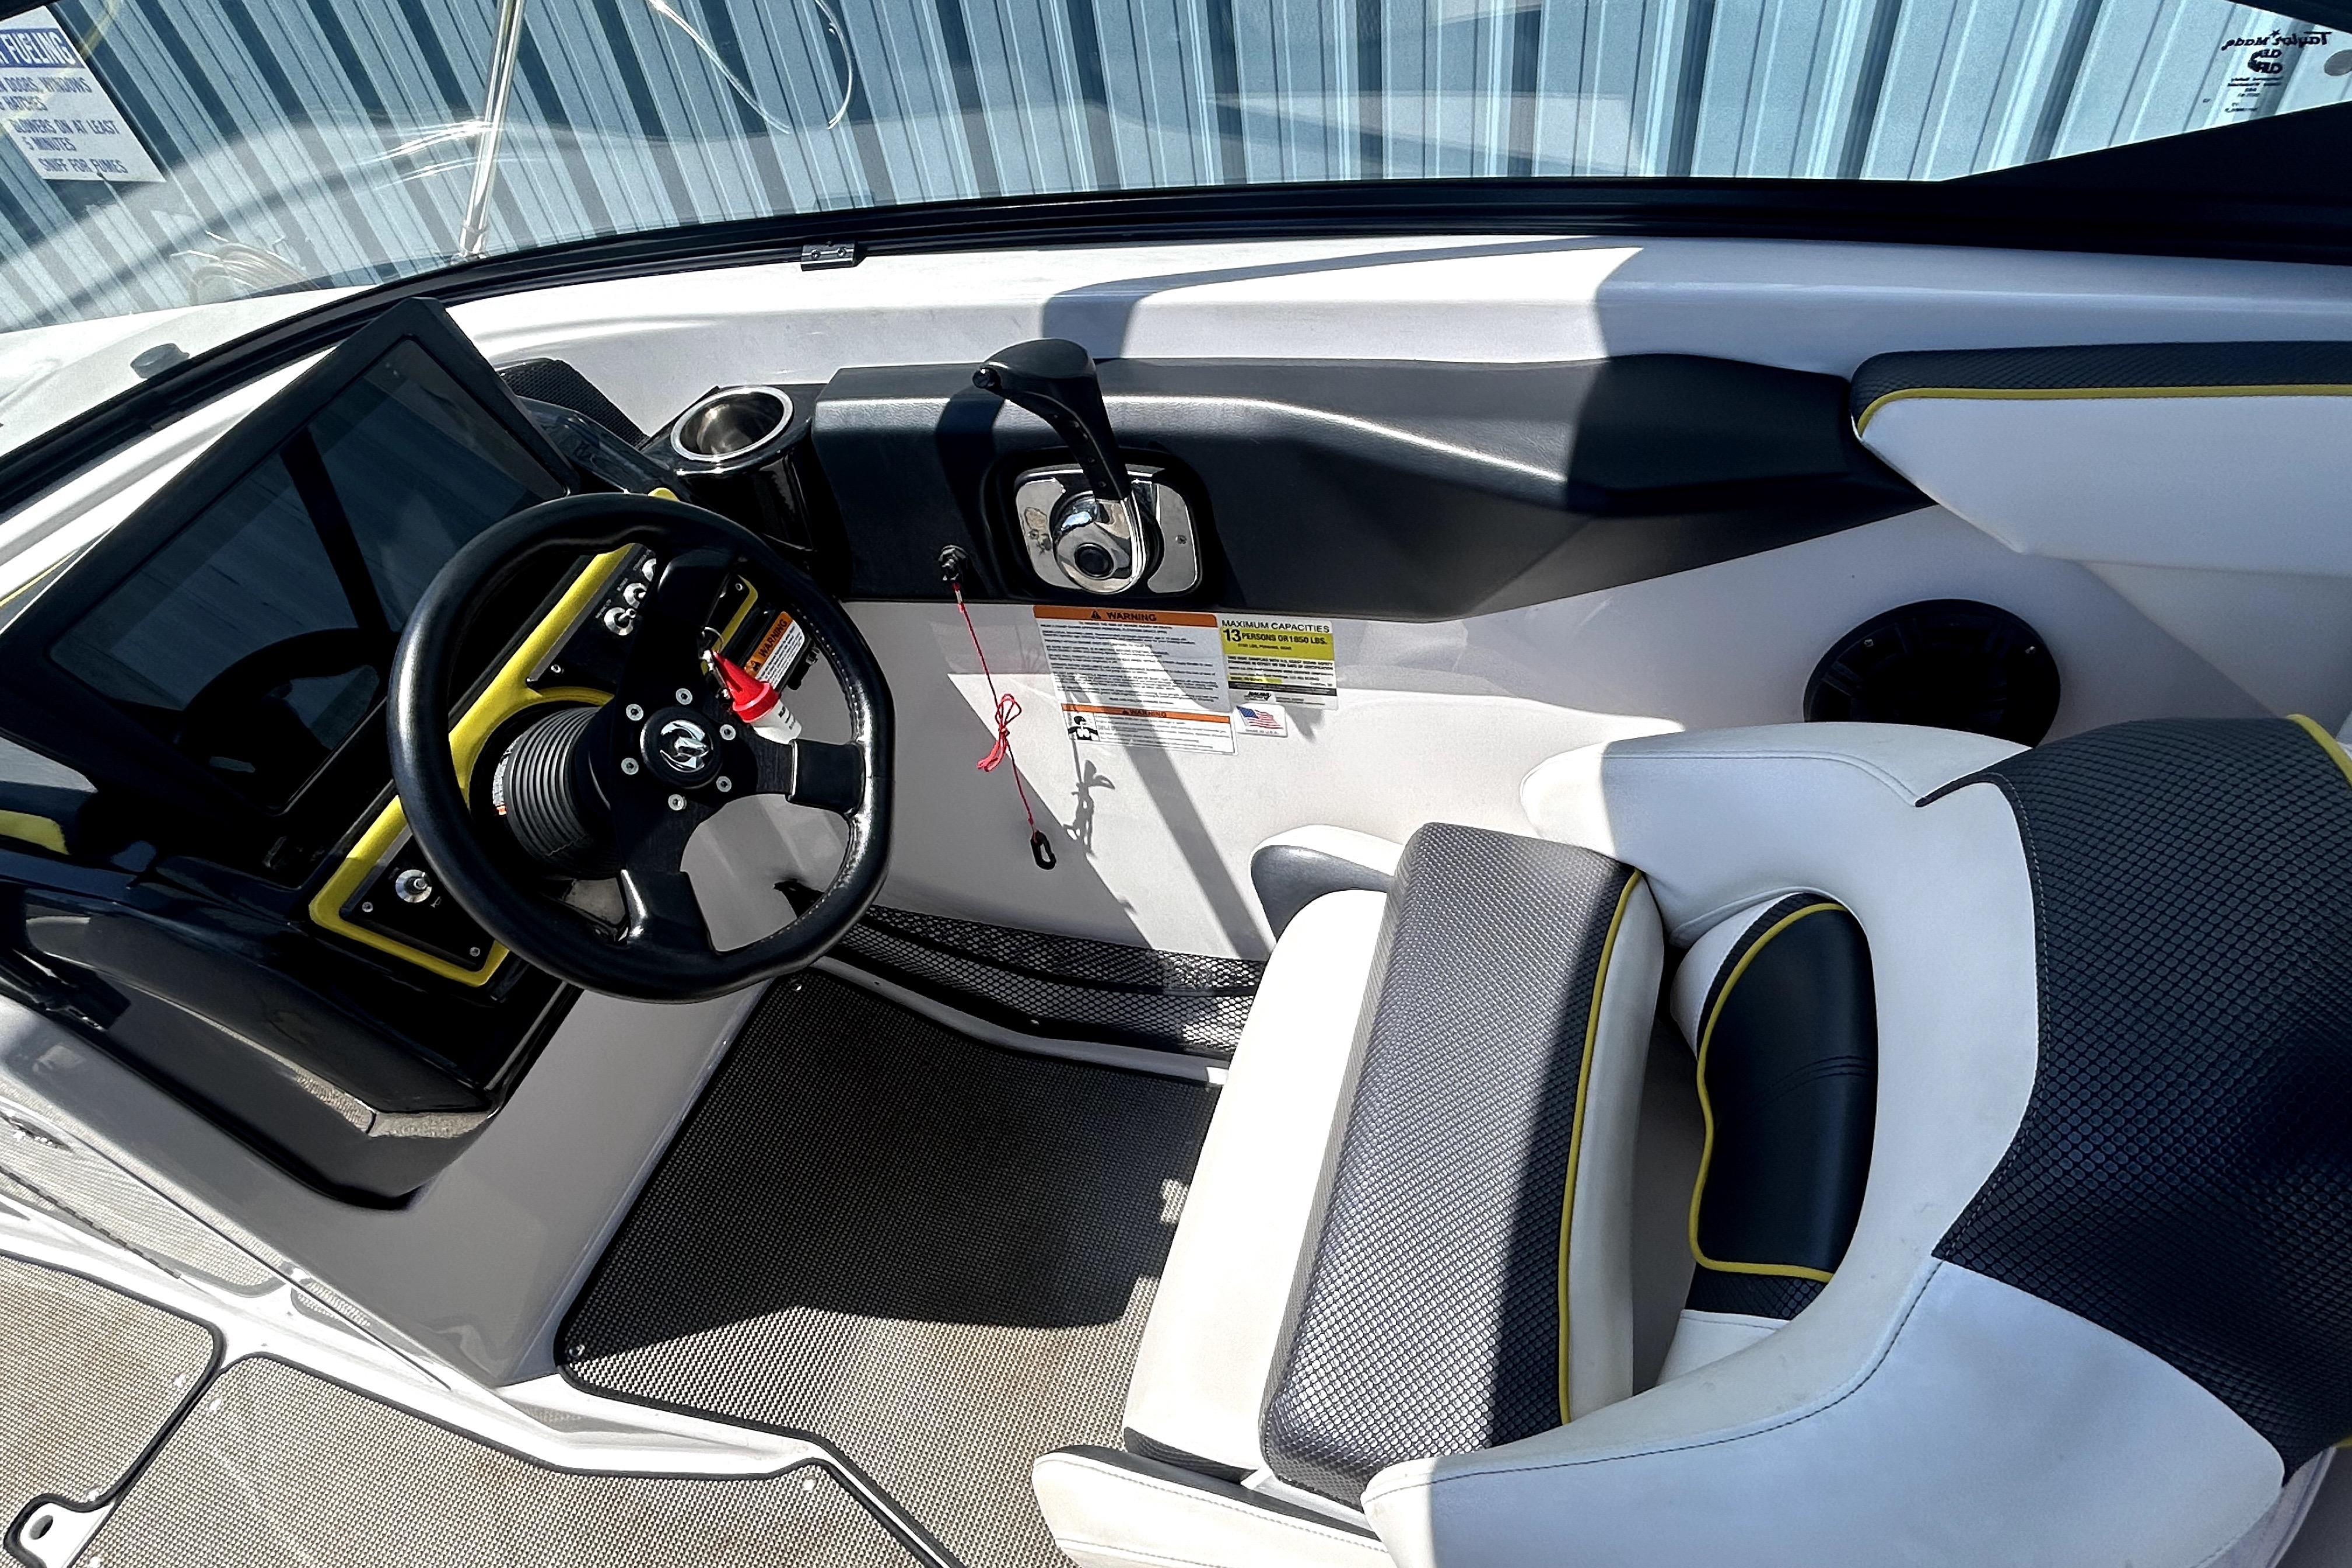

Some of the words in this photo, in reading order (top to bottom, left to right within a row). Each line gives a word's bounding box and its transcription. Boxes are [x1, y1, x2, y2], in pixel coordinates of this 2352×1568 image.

[0, 32, 76, 65] FUELING
[38, 76, 93, 93] WINDOWS
[2, 96, 48, 111] HATCHES
[9, 118, 57, 134] BLOWERS
[54, 119, 74, 134] ON
[71, 120, 89, 134] AT
[86, 120, 120, 134] LEAST
[22, 136, 34, 151] 5
[30, 136, 77, 151] MINUTES
[38, 158, 69, 172] SNIFF
[67, 159, 93, 173] FOR
[89, 159, 128, 173] FUMES
[1107, 612, 1157, 622] WARNING
[1222, 620, 1269, 629] MAXIMUM
[1271, 622, 1330, 633] CAPACITIES
[758, 618, 788, 658] WARNING
[1223, 628, 1241, 642] 13
[1242, 632, 1276, 641] PERSONS
[1278, 635, 1289, 643] OR
[1130, 709, 1167, 718] WARNING
